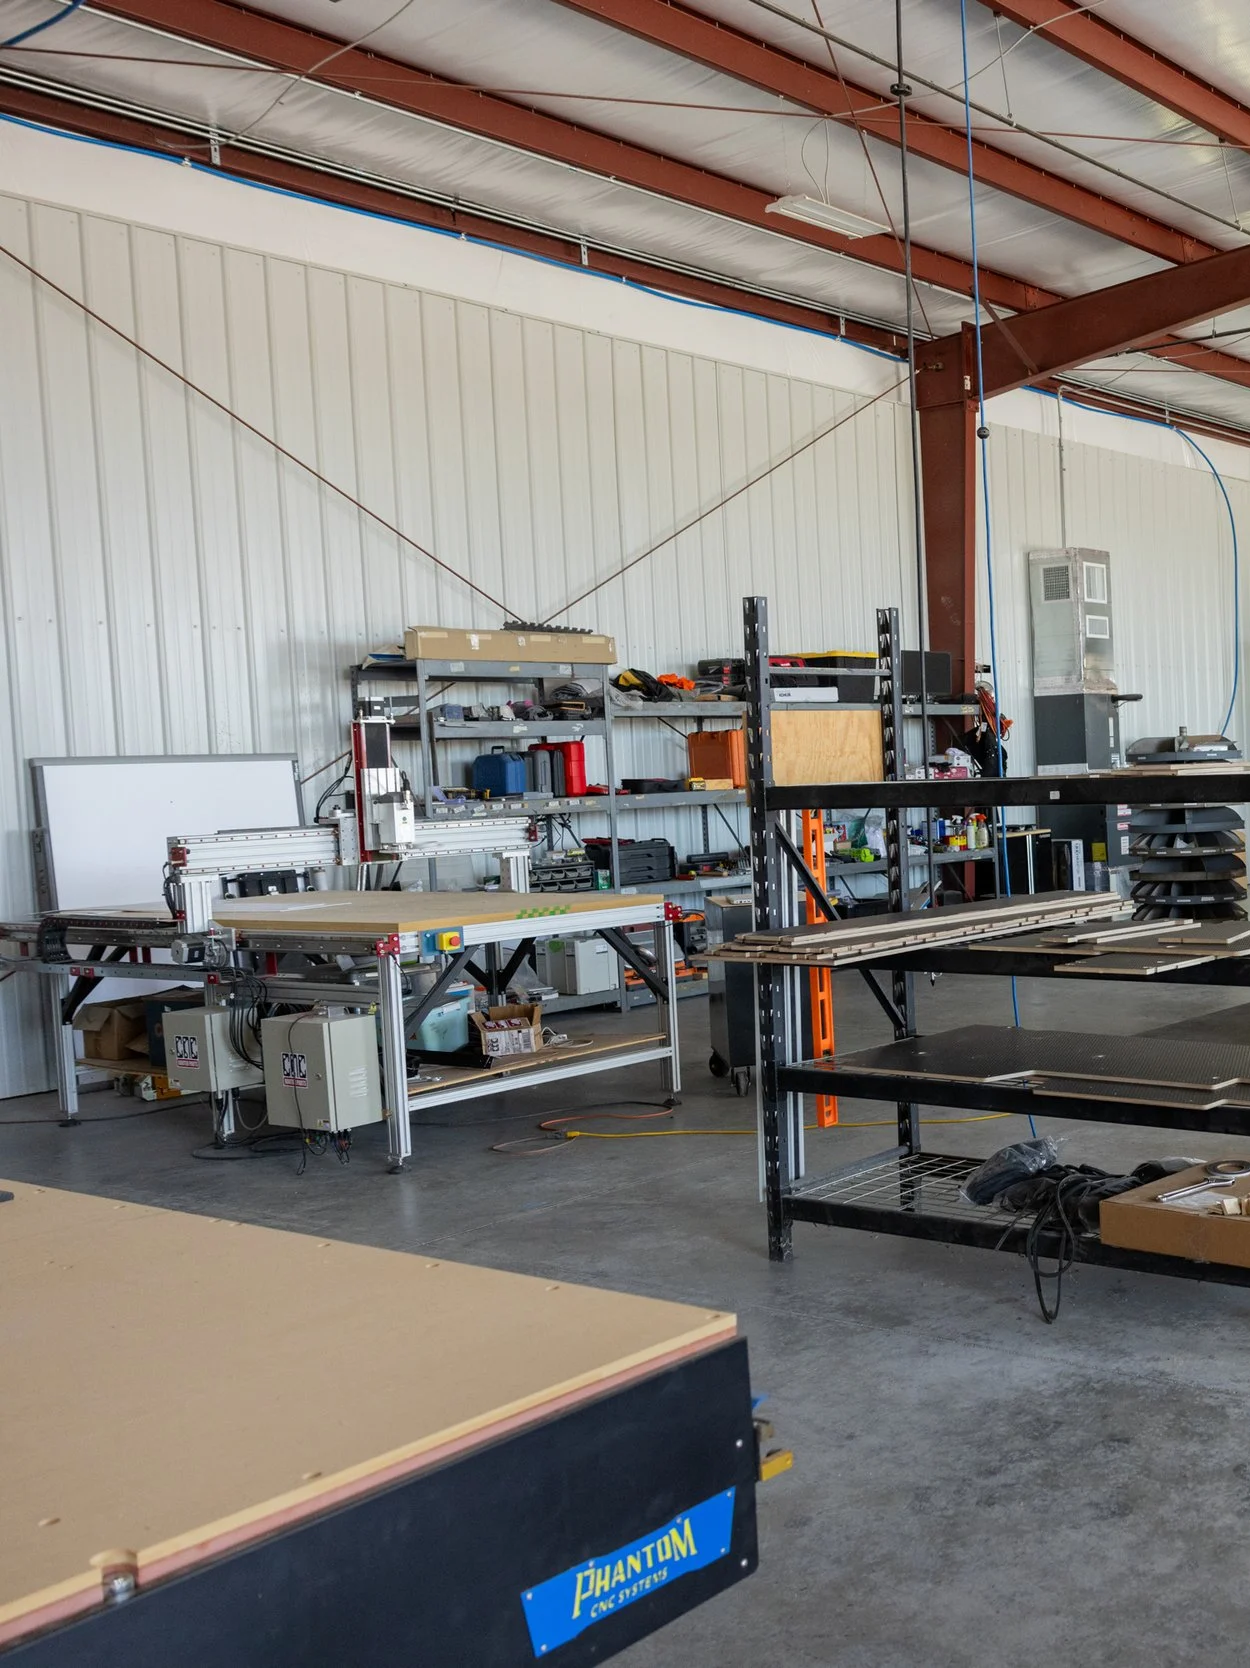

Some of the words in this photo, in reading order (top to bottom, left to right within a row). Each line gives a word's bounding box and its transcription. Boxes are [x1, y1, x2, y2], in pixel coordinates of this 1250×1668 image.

[175, 1036, 198, 1059] CNC
[571, 1517, 698, 1619] PHANTOM
[590, 1594, 615, 1617] CNC
[618, 1566, 668, 1604] SYSTEMS
